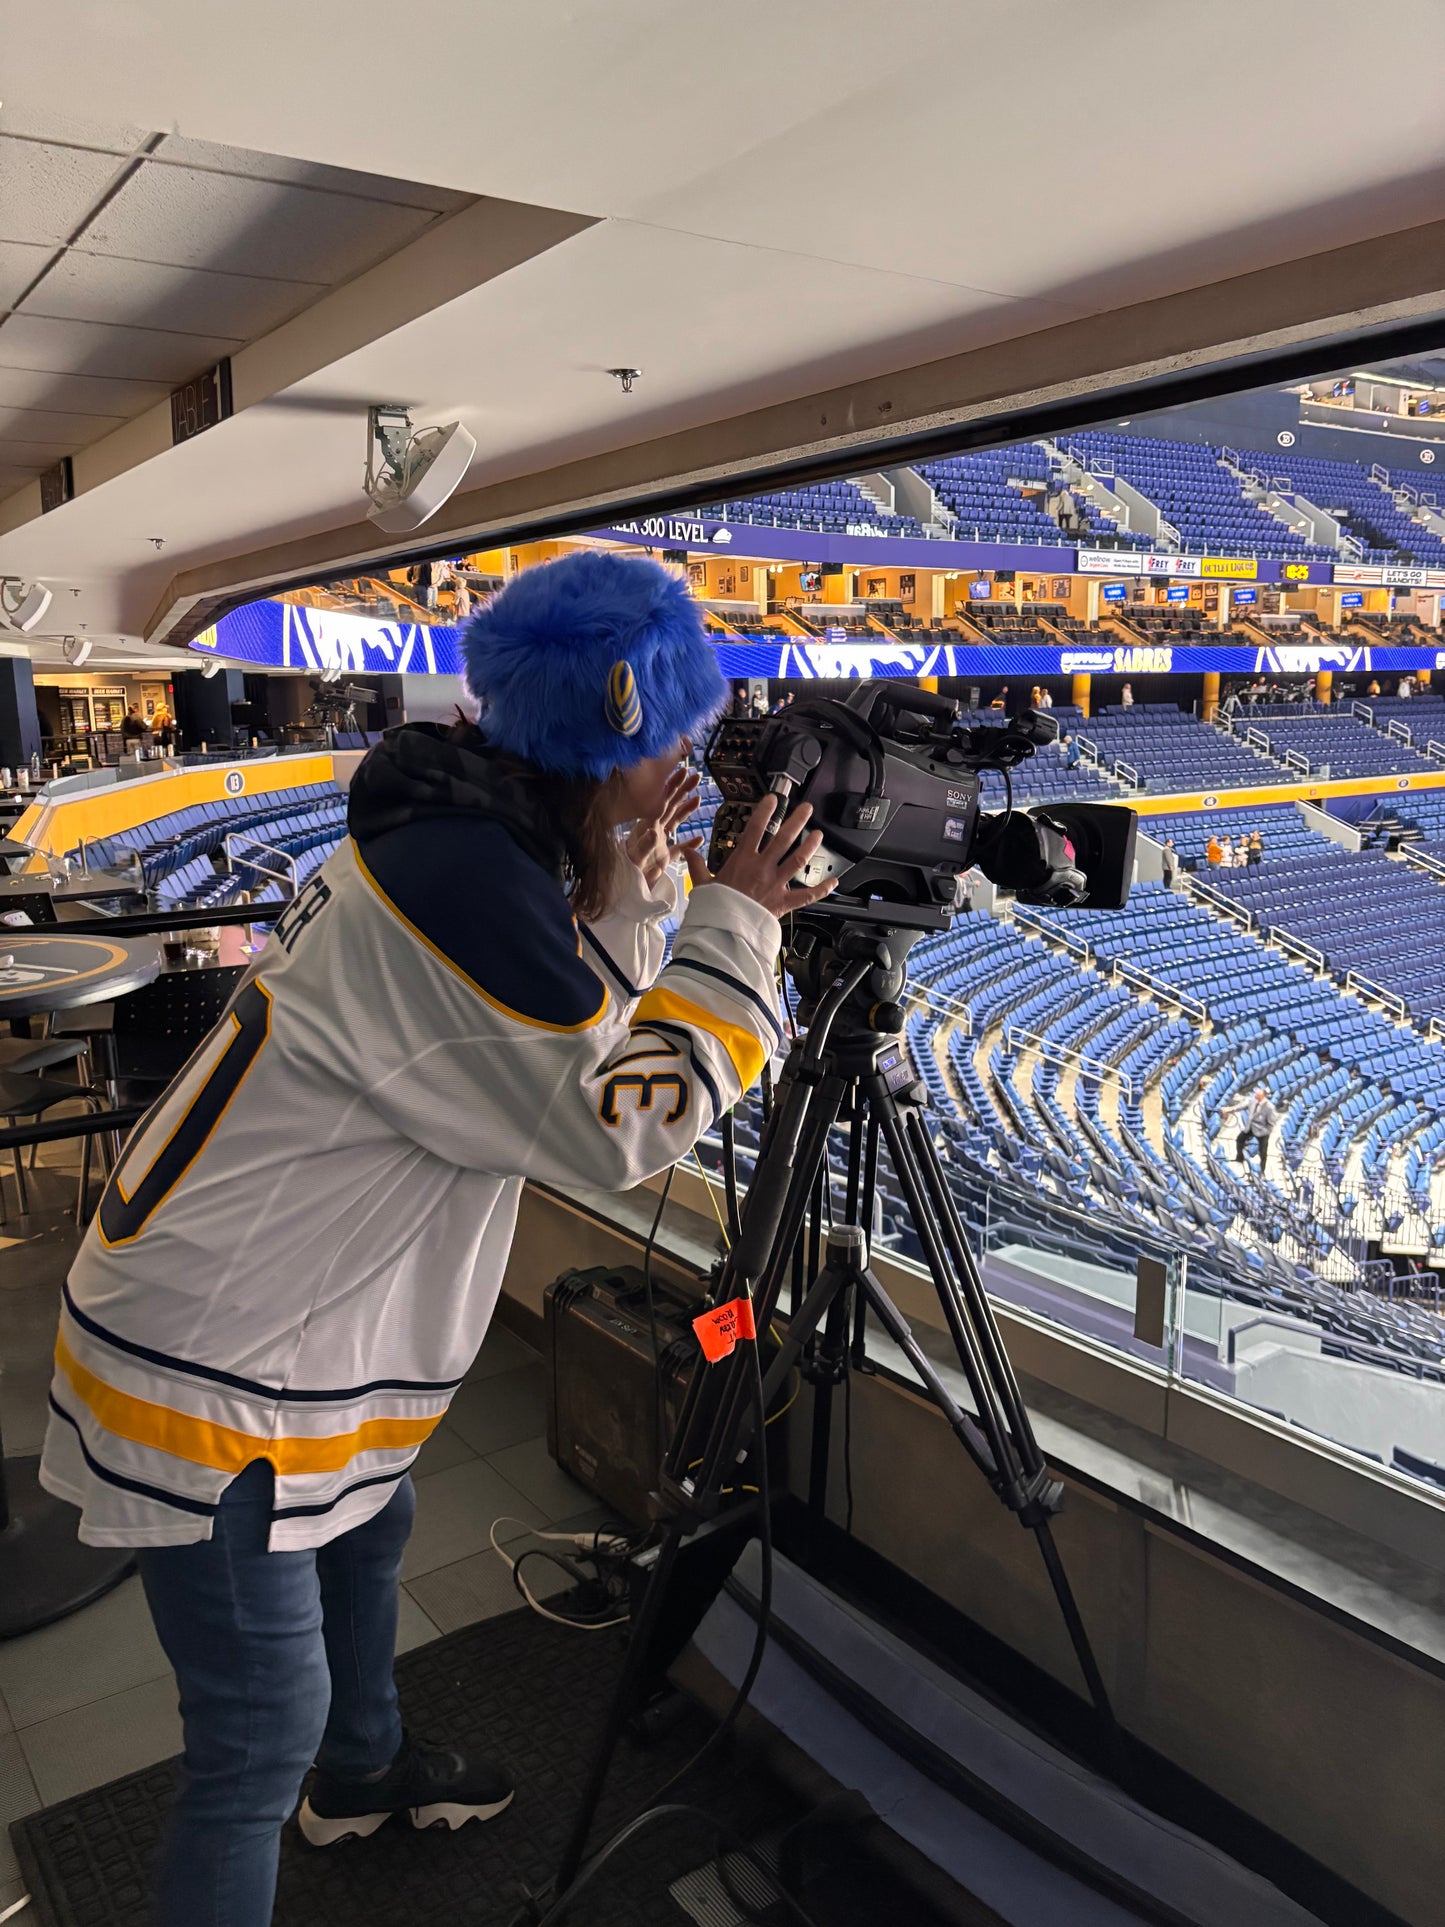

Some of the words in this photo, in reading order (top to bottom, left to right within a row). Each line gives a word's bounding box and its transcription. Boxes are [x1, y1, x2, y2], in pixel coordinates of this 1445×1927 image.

[171, 375, 212, 442] TABLE
[213, 363, 223, 421] 1
[641, 517, 665, 538] 300
[669, 520, 709, 543] LEVEL
[1151, 558, 1168, 569] FREY
[1178, 560, 1195, 570] FREY
[1113, 647, 1172, 672] SABRES
[947, 789, 972, 802] SONY
